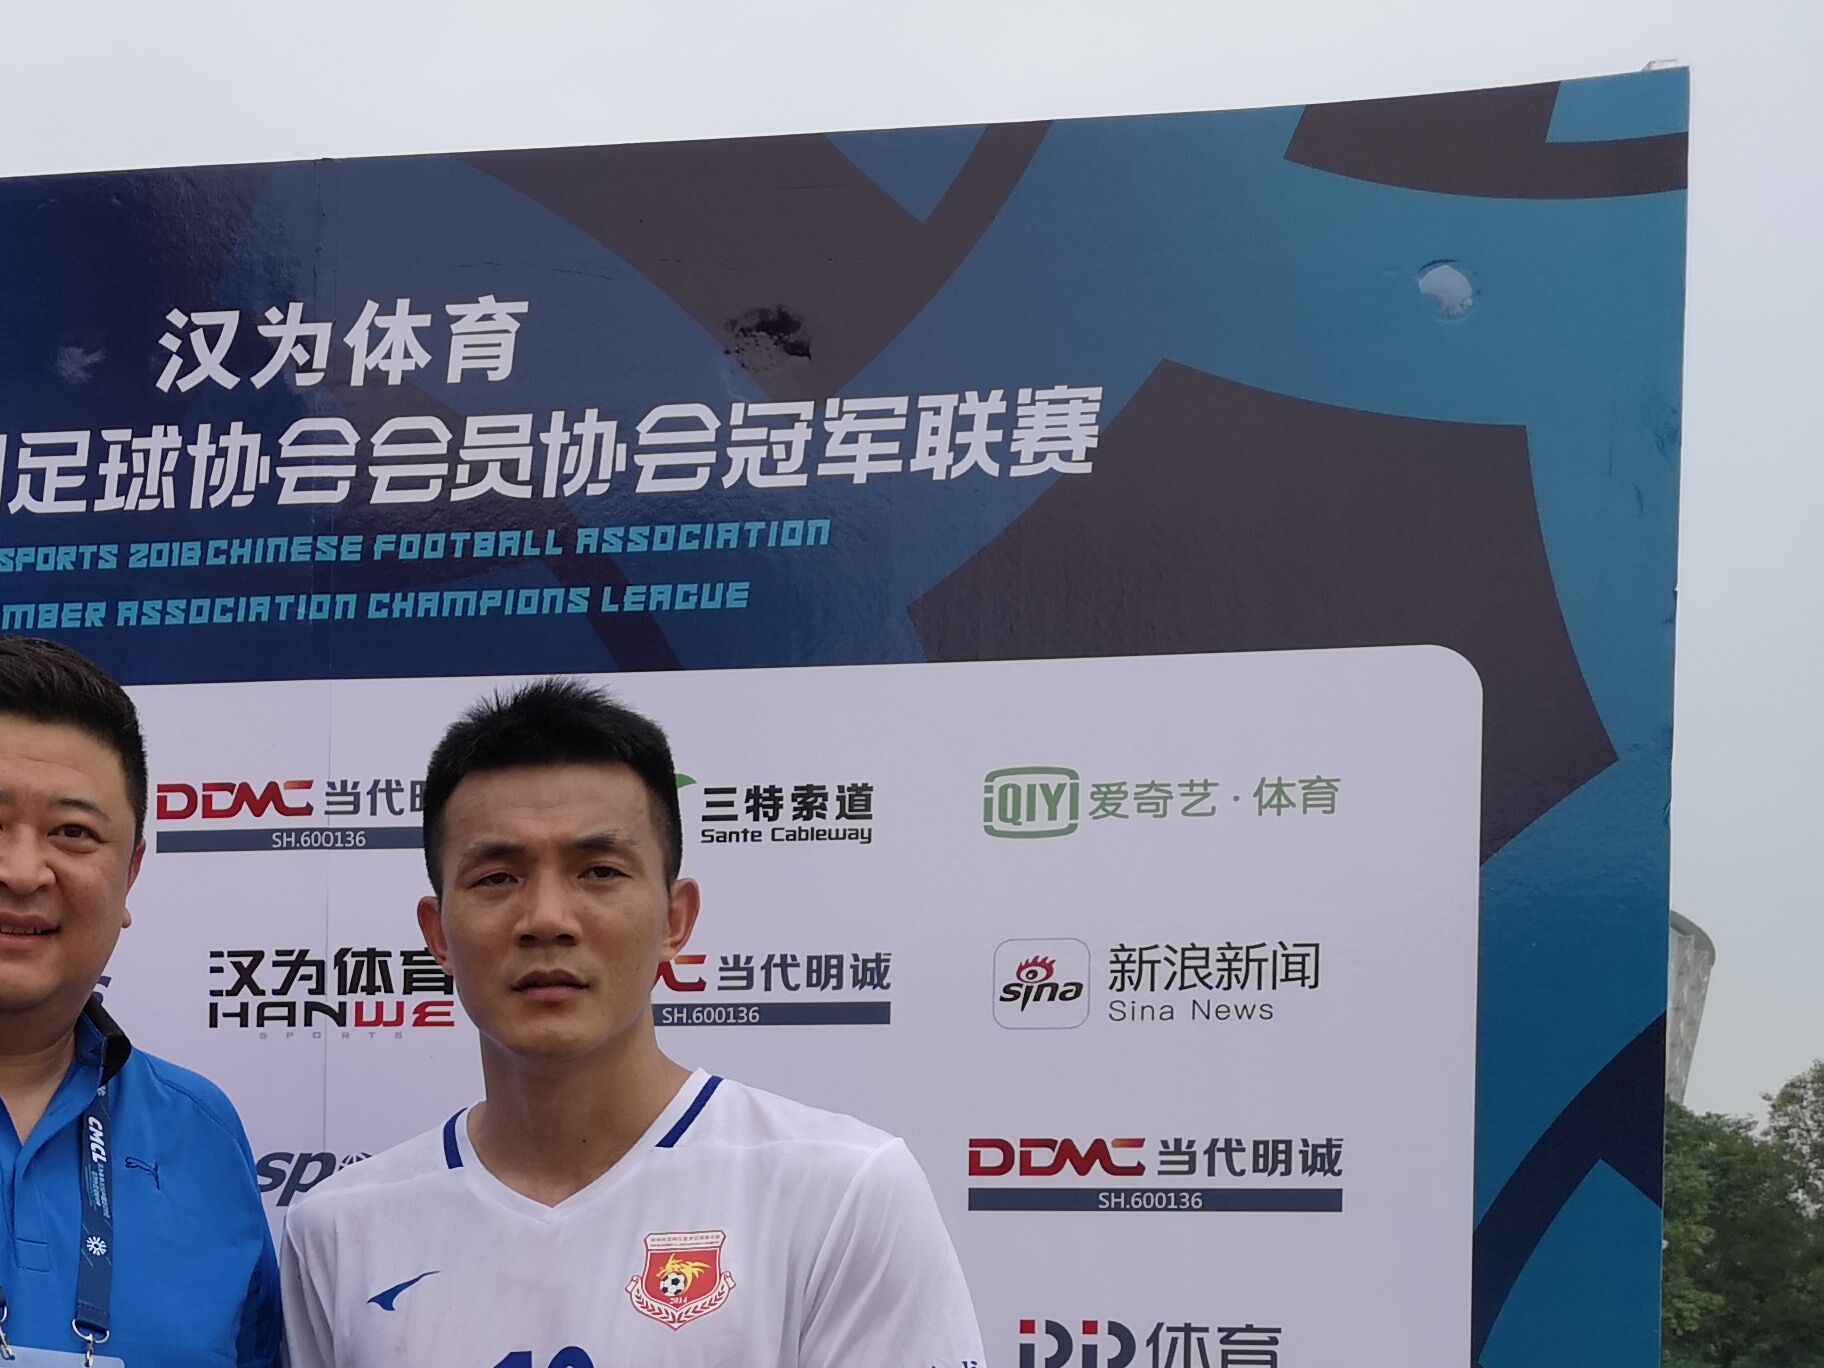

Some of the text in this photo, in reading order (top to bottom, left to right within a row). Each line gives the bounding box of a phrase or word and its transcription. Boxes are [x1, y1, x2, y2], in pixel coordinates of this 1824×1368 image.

[155, 295, 529, 393] 汉为体育
[373, 530, 564, 561] FOOTBALL
[576, 519, 831, 554] ASSOCIATION
[116, 593, 358, 627] ASSOCIATION
[367, 587, 591, 620] CHAMPIONS
[601, 581, 751, 613] LEAGUE
[156, 779, 314, 820] DDMC
[701, 782, 874, 822] 三特索道
[272, 831, 366, 848] SH.600136
[701, 826, 873, 844] Sante Cableway
[209, 947, 454, 997] 汉为体育
[718, 952, 892, 991] 当代明诚
[1108, 941, 1321, 992] 新浪新闻
[209, 1000, 455, 1028] HANWE
[662, 1006, 760, 1024] SH.600136
[999, 981, 1084, 1011] sina
[1108, 998, 1274, 1022] Sina News
[259, 1031, 403, 1040] SPORTS
[968, 1137, 1344, 1178] DDMC 当代明诚
[1098, 1191, 1203, 1209] SH.600136
